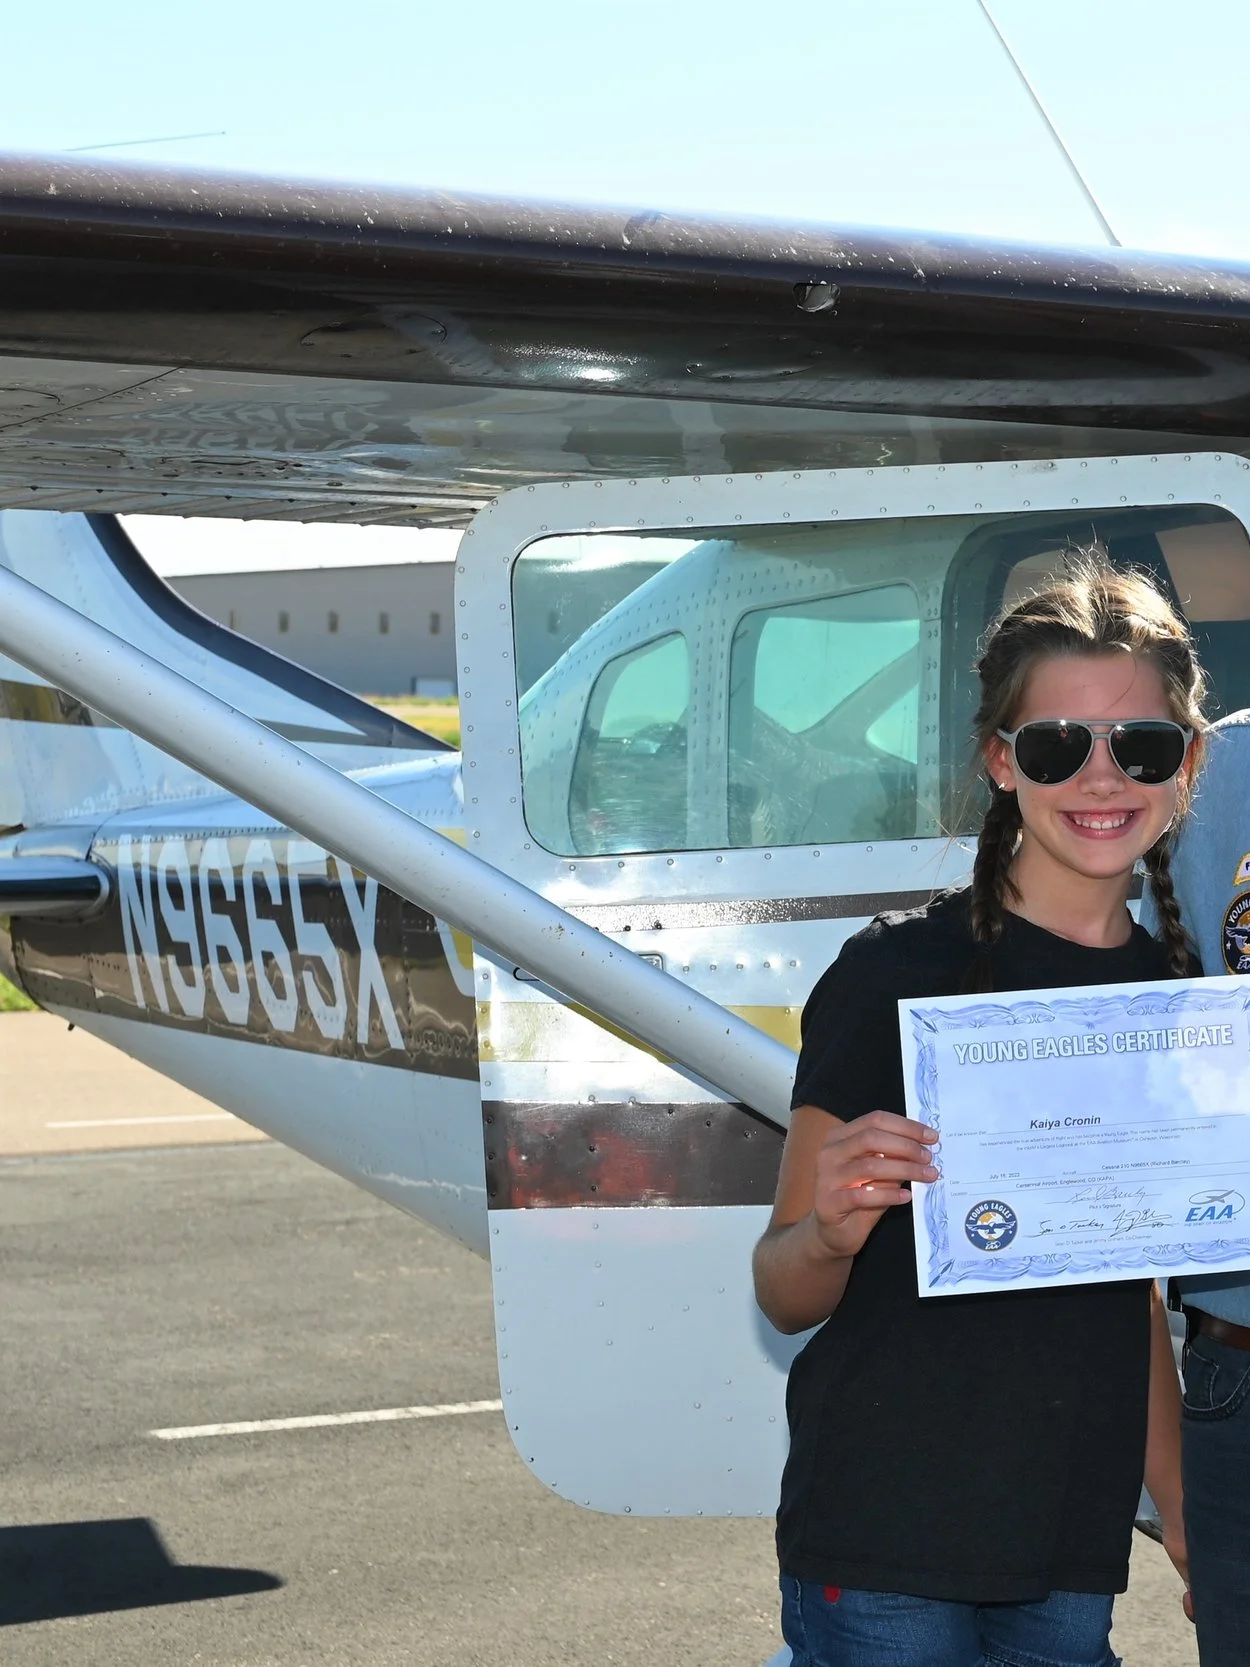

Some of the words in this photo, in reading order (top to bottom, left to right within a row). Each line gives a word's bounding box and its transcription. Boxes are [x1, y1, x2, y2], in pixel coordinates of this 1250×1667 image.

[117, 833, 404, 1050] N9665X
[953, 1039, 1027, 1065] YOUNG
[1032, 1033, 1108, 1059] EAGLES
[1112, 1024, 1233, 1053] CERTIFICATE
[1030, 1118, 1060, 1131] Kaiya
[1064, 1115, 1101, 1127] Cronin
[969, 1203, 989, 1222] YOUNG
[991, 1203, 1013, 1219] EAGLES
[1185, 1204, 1233, 1222] EAA
